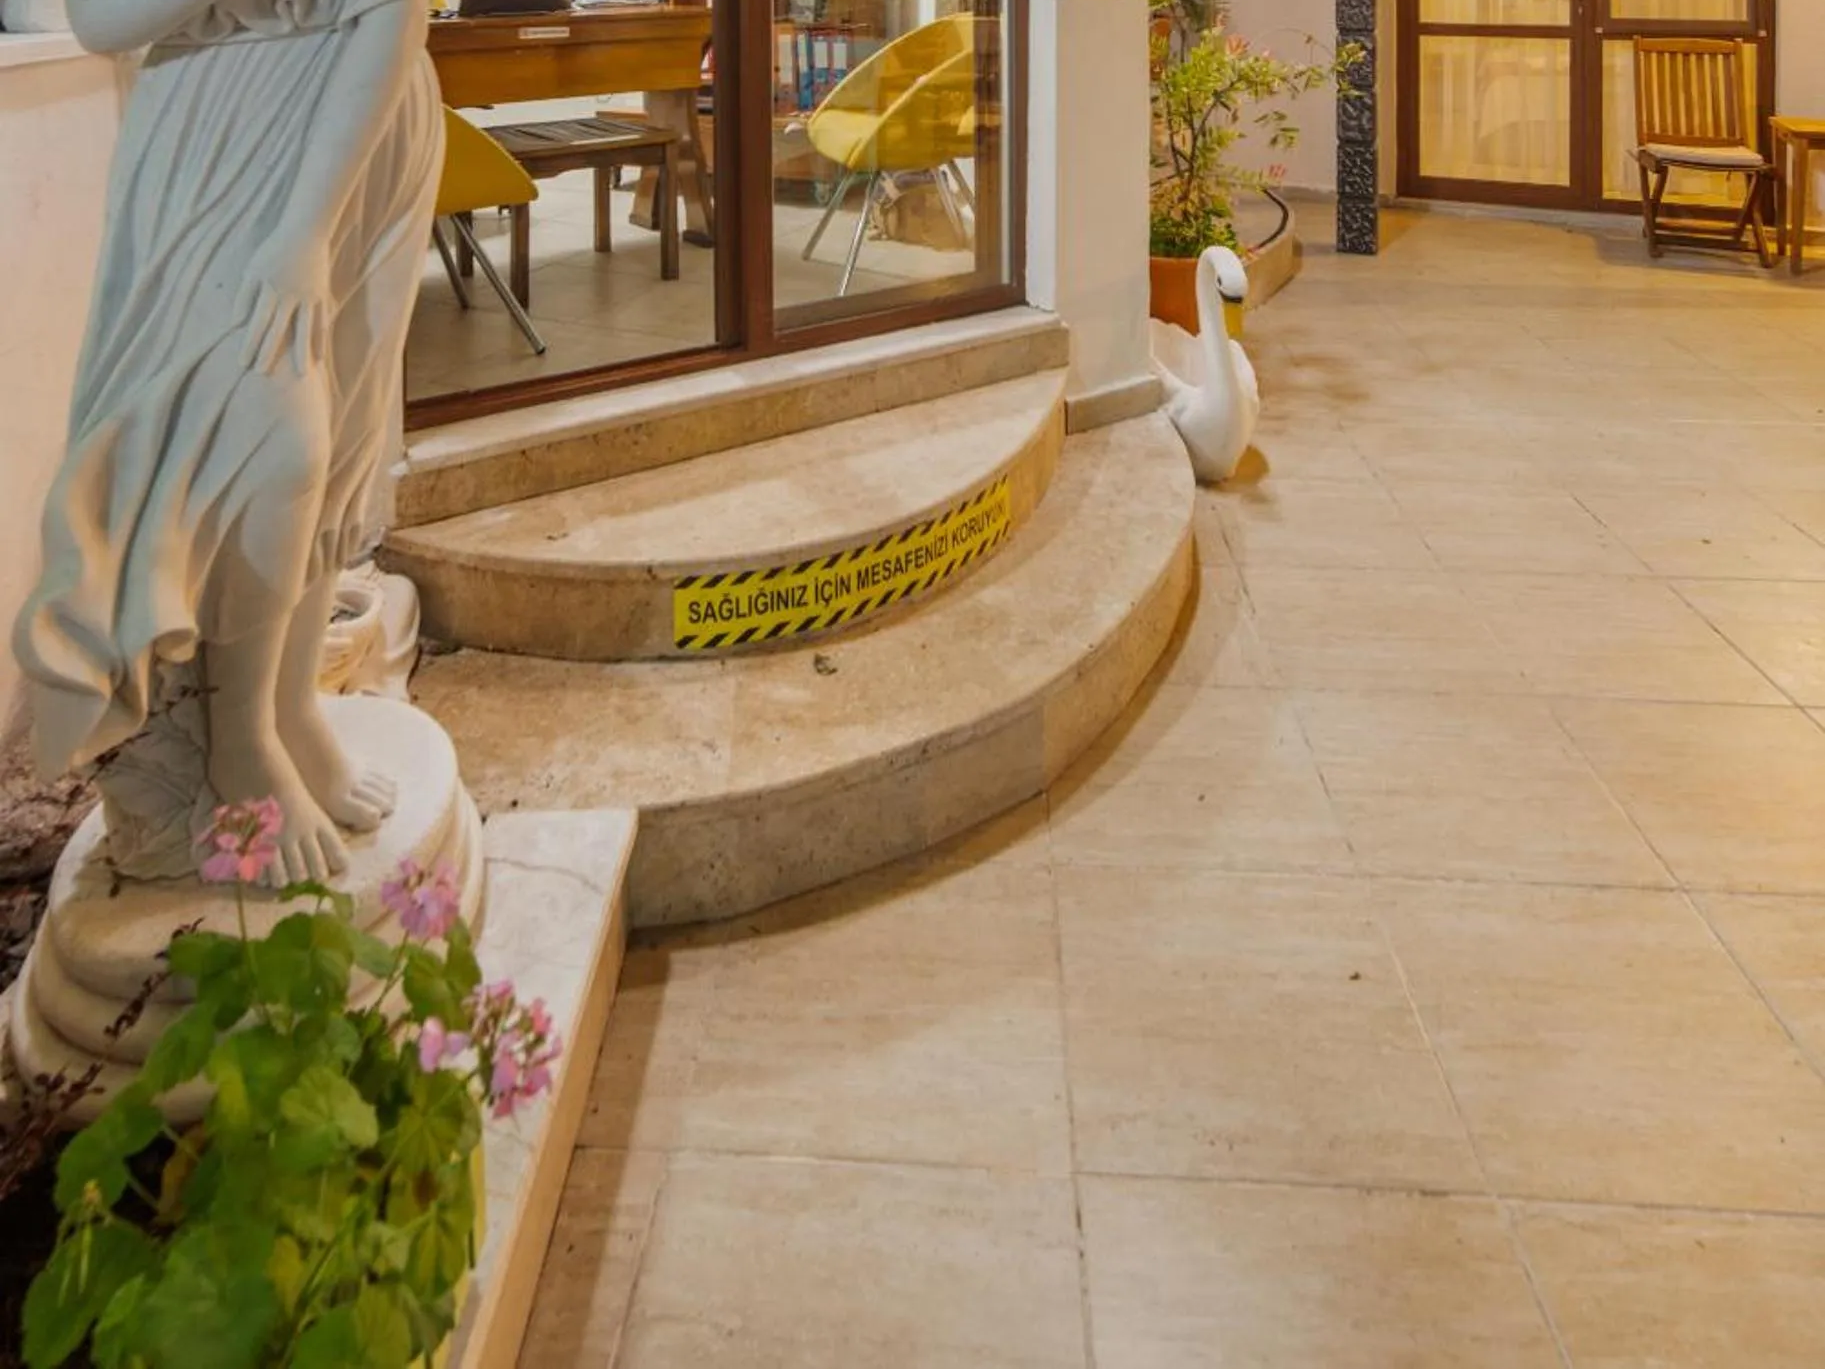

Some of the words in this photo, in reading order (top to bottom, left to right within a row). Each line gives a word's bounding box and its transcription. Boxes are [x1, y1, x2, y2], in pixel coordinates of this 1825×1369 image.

[688, 585, 808, 624] SAĞLIĞINIZ
[814, 574, 851, 608] İÇİN
[856, 535, 948, 592] MESAFENİZİ
[952, 500, 1006, 550] KORUYUN
